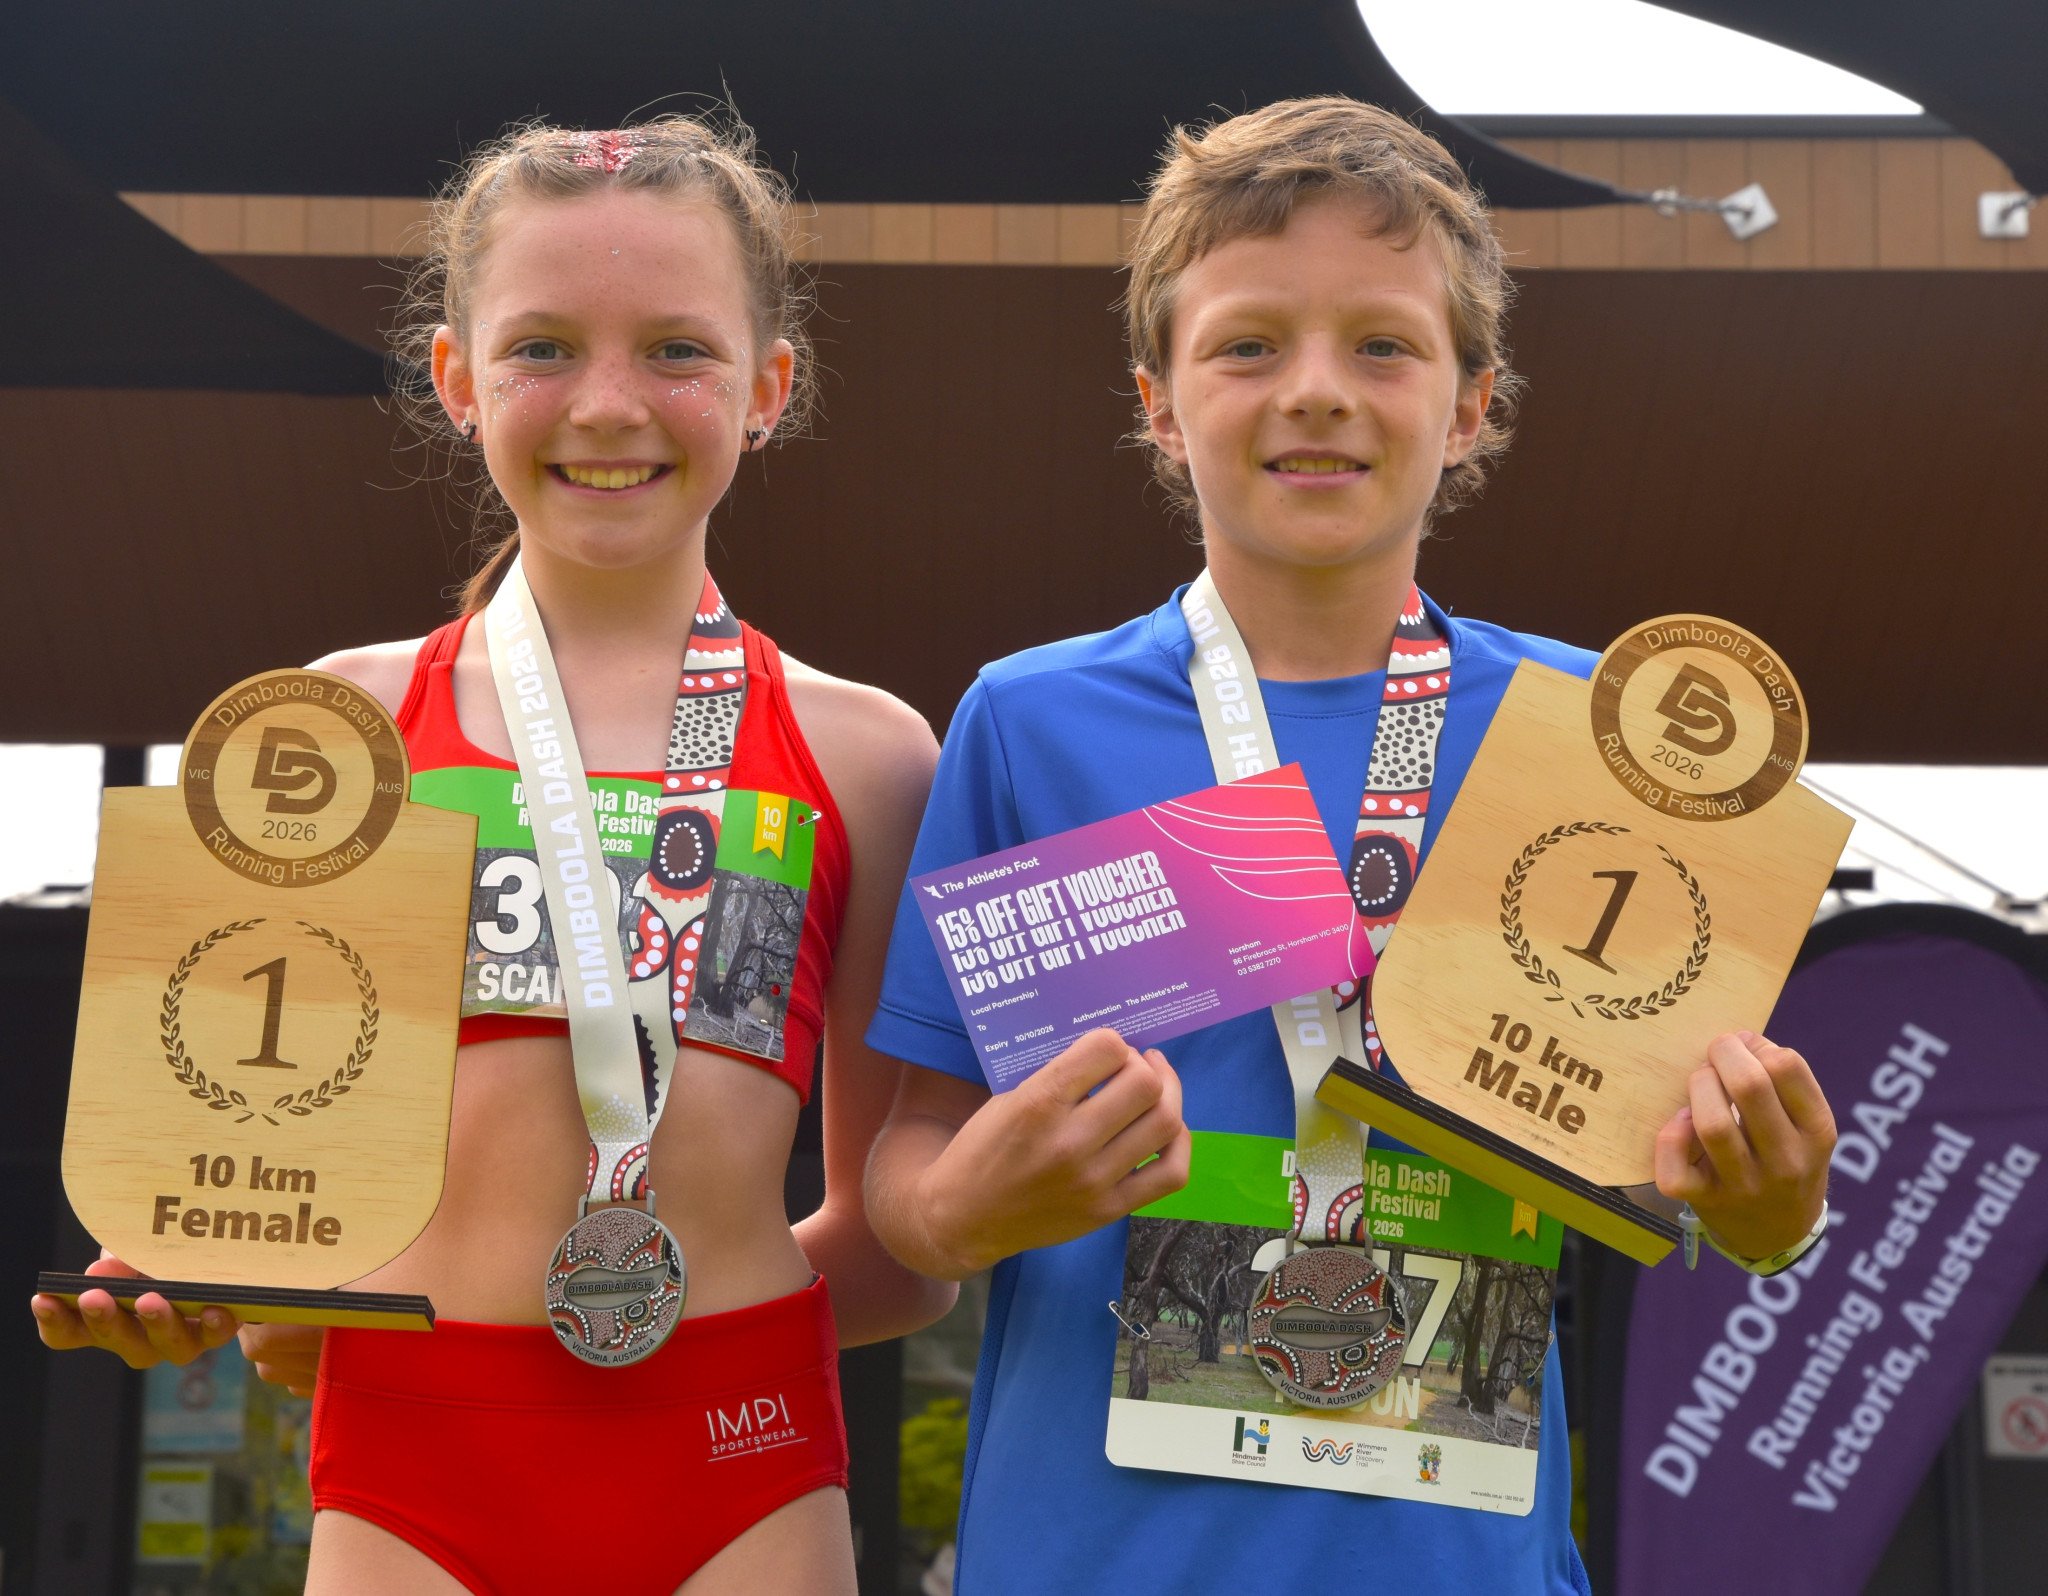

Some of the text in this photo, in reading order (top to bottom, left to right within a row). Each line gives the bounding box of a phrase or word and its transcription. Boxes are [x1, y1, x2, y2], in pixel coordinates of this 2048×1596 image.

[507, 638, 549, 714] 2026
[1602, 671, 1623, 688] VIC
[1644, 623, 1794, 712] Dimboola Dash
[1203, 644, 1250, 725] 2026
[215, 678, 381, 738] Dimboola Dash
[188, 768, 210, 780] VIC
[526, 718, 573, 805] DASH
[1600, 732, 1746, 816] Running Festival
[1650, 744, 1704, 780] 2026
[1768, 753, 1795, 772] AUS
[376, 782, 403, 794] AUS
[261, 820, 317, 841] 2026
[762, 806, 781, 825] 10
[602, 839, 632, 853] 2026
[762, 827, 777, 842] km
[206, 826, 370, 884] Running Festival
[942, 856, 1040, 894] The Athlete's Foot
[551, 811, 614, 1008] DIMBOOLA
[935, 851, 1168, 951] 15% OFF GIFT VOUCHER
[1562, 870, 1638, 976] 1
[1229, 940, 1261, 955] Horsham
[1243, 947, 1277, 963] Firebrace
[1288, 934, 1319, 948] Horsham
[1319, 929, 1331, 938] VIC
[1331, 923, 1349, 935] 3400
[236, 956, 298, 1070] 1
[970, 1002, 992, 1016] Local
[992, 991, 1035, 1010] Partnership
[1073, 1003, 1122, 1025] Authorisation
[1125, 999, 1140, 1007] The
[1140, 988, 1172, 1003] Athlete's
[1172, 981, 1189, 993] Foot
[977, 1024, 987, 1032] To
[985, 1024, 1055, 1053] Expiry 30/10/2026
[1489, 1013, 1604, 1093] 10 km
[1463, 1046, 1587, 1135] Male
[188, 1153, 316, 1193] 10 km
[1397, 1163, 1451, 1197] Dash
[1370, 1190, 1441, 1221] Festival
[1519, 1208, 1532, 1223] km
[152, 1195, 342, 1247] Female
[1373, 1219, 1404, 1238] 2026
[1643, 1021, 1951, 1498] DIMBOOL DASH
[568, 1279, 654, 1295] DIMBOOLA DASH
[1747, 1121, 1975, 1471] Running Festival
[1275, 1321, 1371, 1333] DIMBOOLA DASH
[1792, 1142, 2041, 1514] Victoria, Australia
[572, 1337, 656, 1364] VICTORIA, AUSTRALIA
[1326, 1383, 1376, 1406] AUSTRALIA
[706, 1393, 790, 1441] IMPI
[711, 1428, 797, 1454] SPORTSWEAR
[1356, 1442, 1387, 1452] Wimmera
[1356, 1448, 1372, 1456] River
[1231, 1458, 1266, 1468] Shire Council
[1232, 1452, 1267, 1462] Hindmarsh
[1355, 1455, 1385, 1464] Discovery
[1355, 1460, 1369, 1468] Trail
